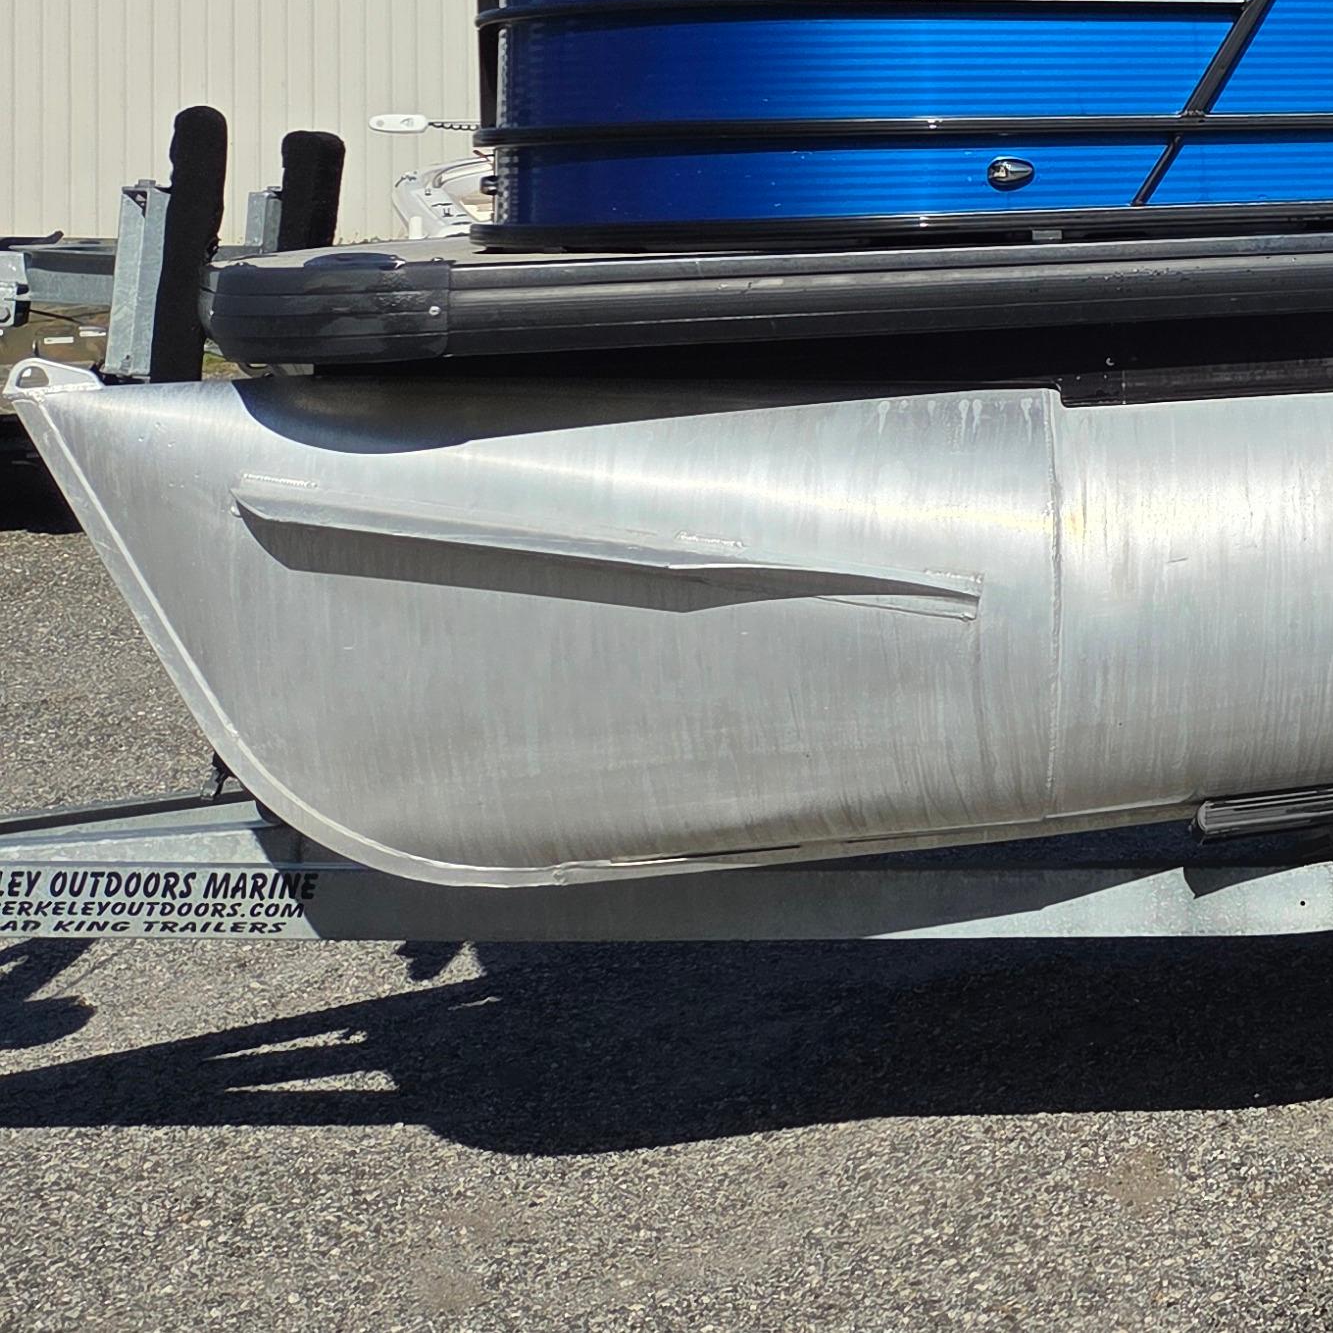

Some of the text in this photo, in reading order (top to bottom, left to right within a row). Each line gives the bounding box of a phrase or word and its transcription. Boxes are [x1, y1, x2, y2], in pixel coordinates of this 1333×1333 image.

[49, 870, 197, 900] OUTDOORS
[203, 872, 319, 901] MARINE
[0, 900, 304, 918] ERKELEYOUTDOORS.COM
[52, 920, 130, 933] KING
[143, 920, 287, 934] TRAILERS
